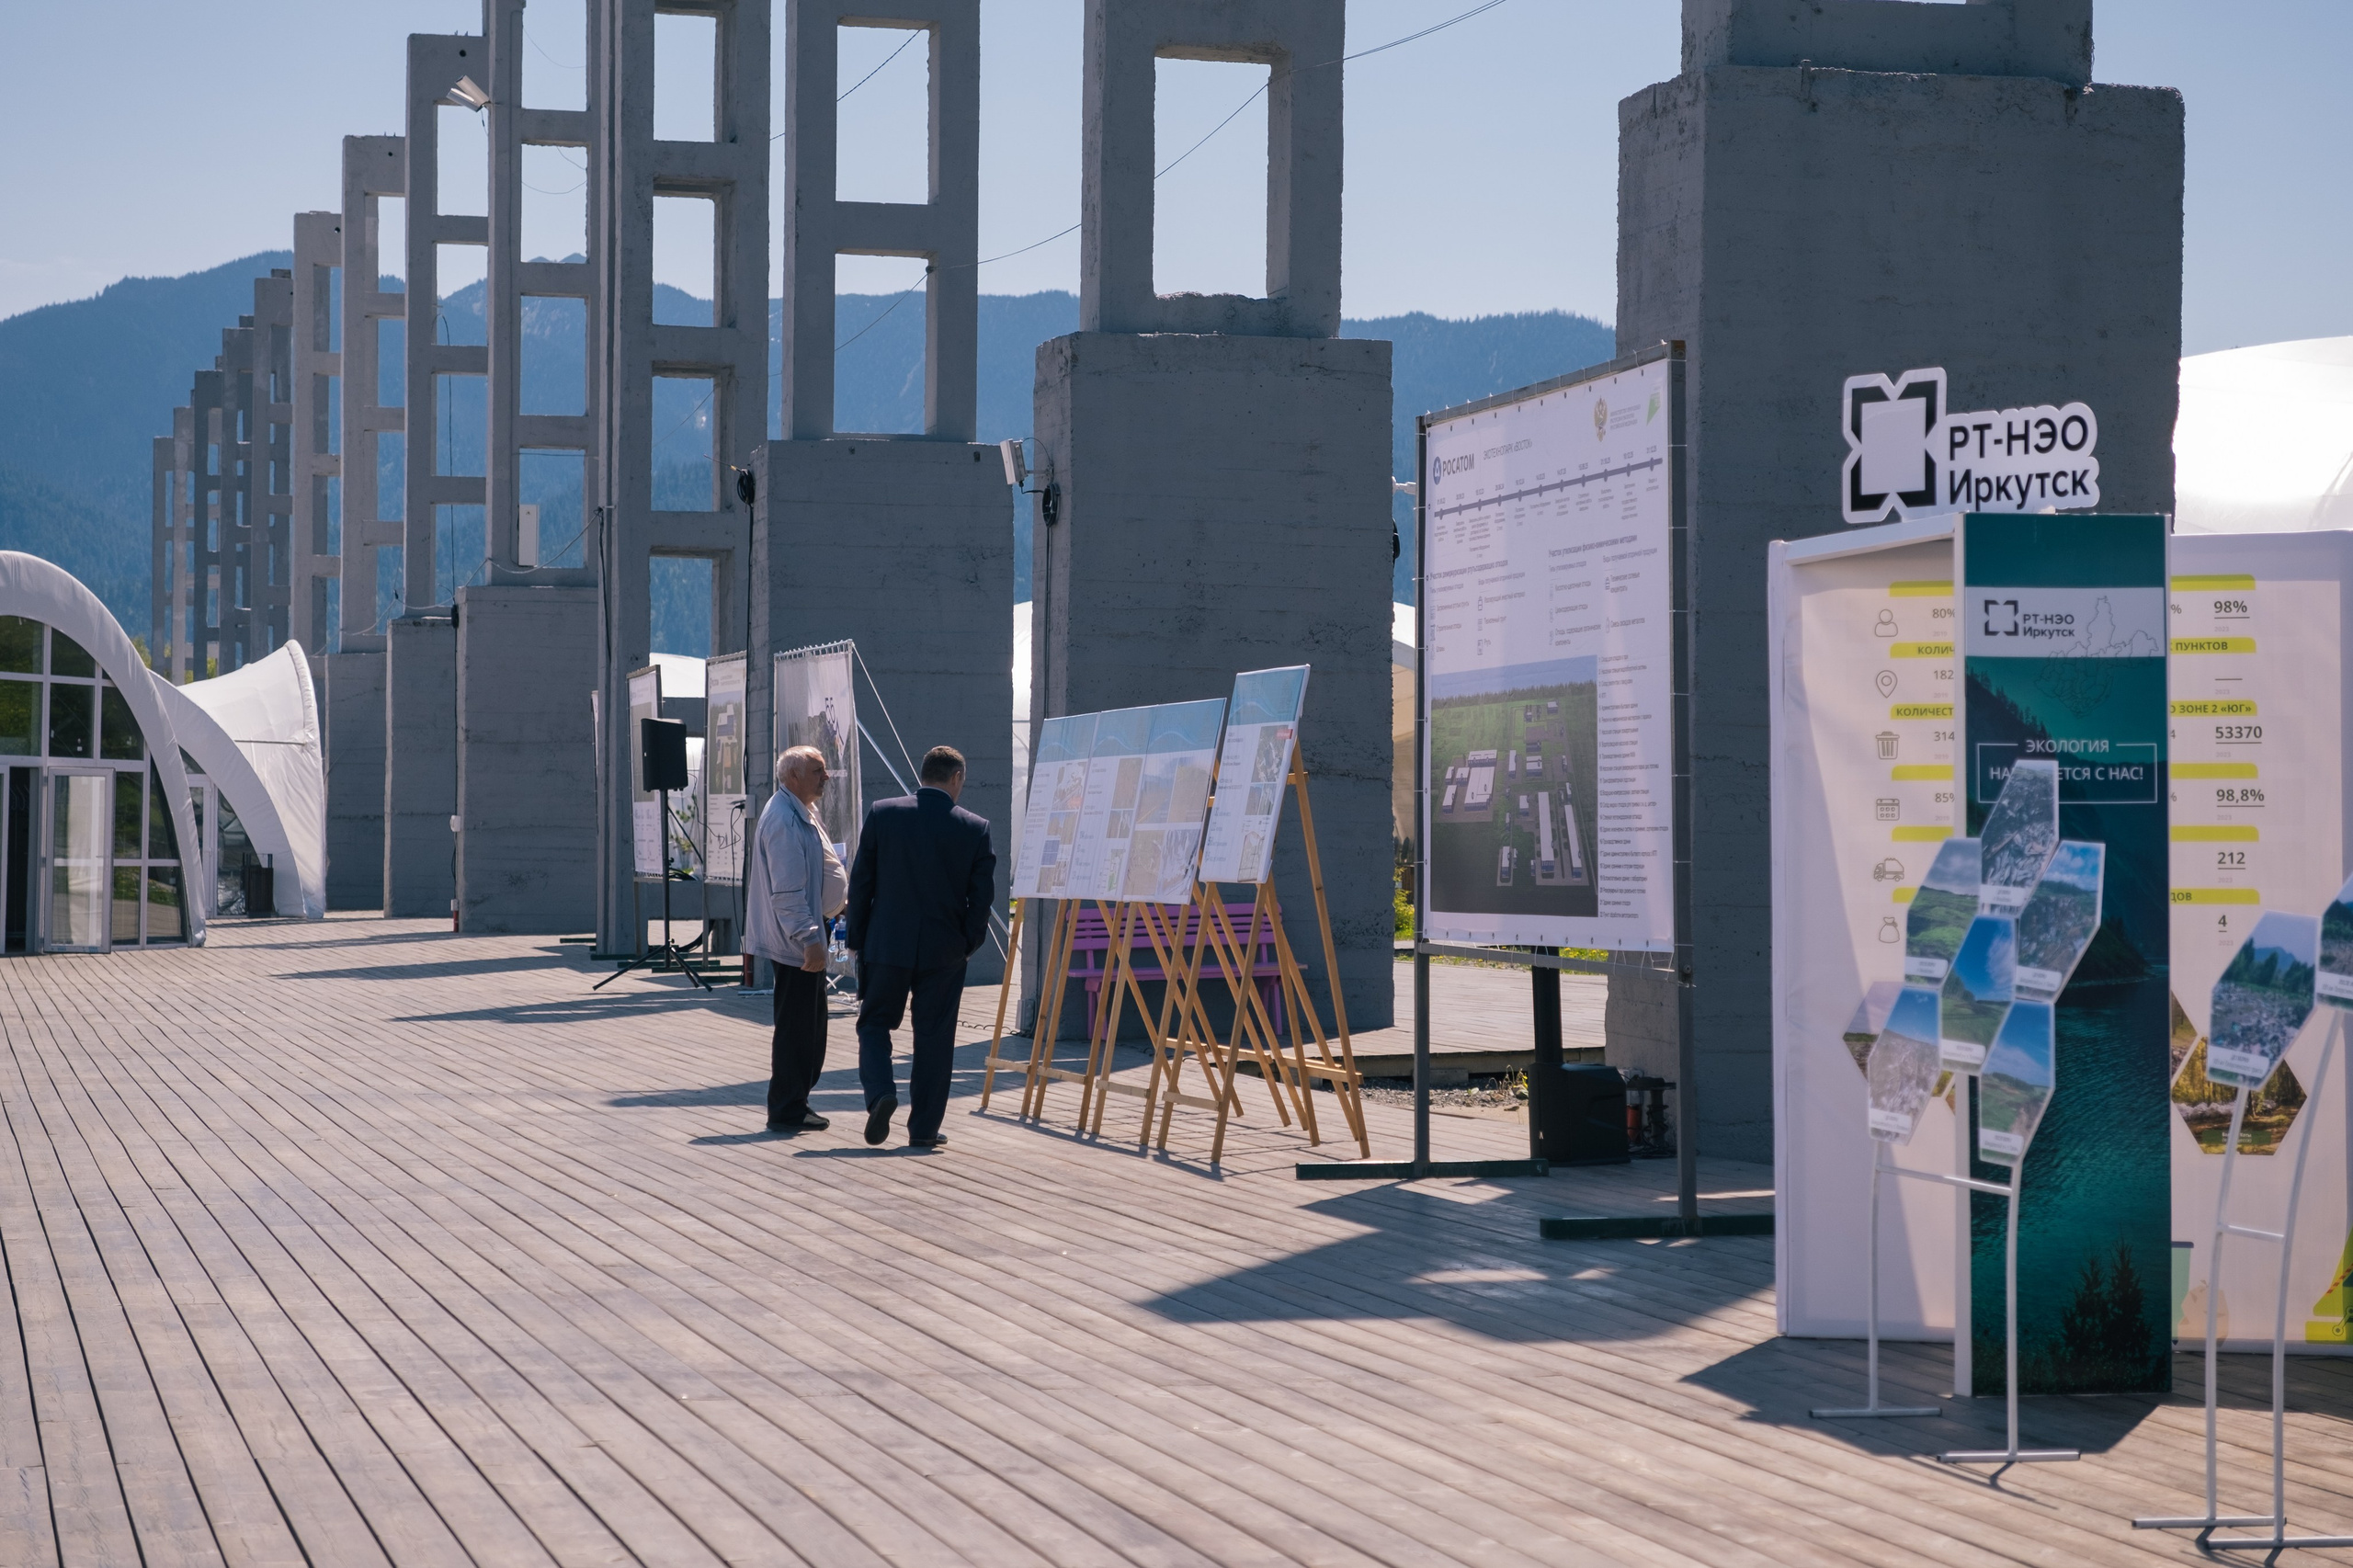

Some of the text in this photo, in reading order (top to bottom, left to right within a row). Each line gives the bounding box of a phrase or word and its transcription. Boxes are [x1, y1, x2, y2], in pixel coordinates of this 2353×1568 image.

[1949, 415, 2088, 461] РТ-НЭО
[1443, 453, 1474, 477] РОСАТОМ
[1949, 469, 2090, 512] Иркутск
[2213, 600, 2248, 613] 98%
[2023, 614, 2075, 625] РТ-НЭО
[2023, 627, 2075, 638] Иркутск
[2176, 642, 2228, 652] ПУНКТОВ
[1934, 670, 1954, 680] 182
[2179, 704, 2209, 713] ЗОНЕ
[2211, 704, 2218, 713] 2
[2221, 703, 2252, 713] «ЮГ»
[2215, 726, 2262, 739] 53370
[2025, 739, 2109, 753] ЭКОЛОГИЯ
[2095, 767, 2105, 780] С
[2109, 767, 2143, 780] НАС!
[2216, 789, 2265, 804] 98,8%
[2217, 852, 2245, 865] 212
[2218, 915, 2227, 927] 4
